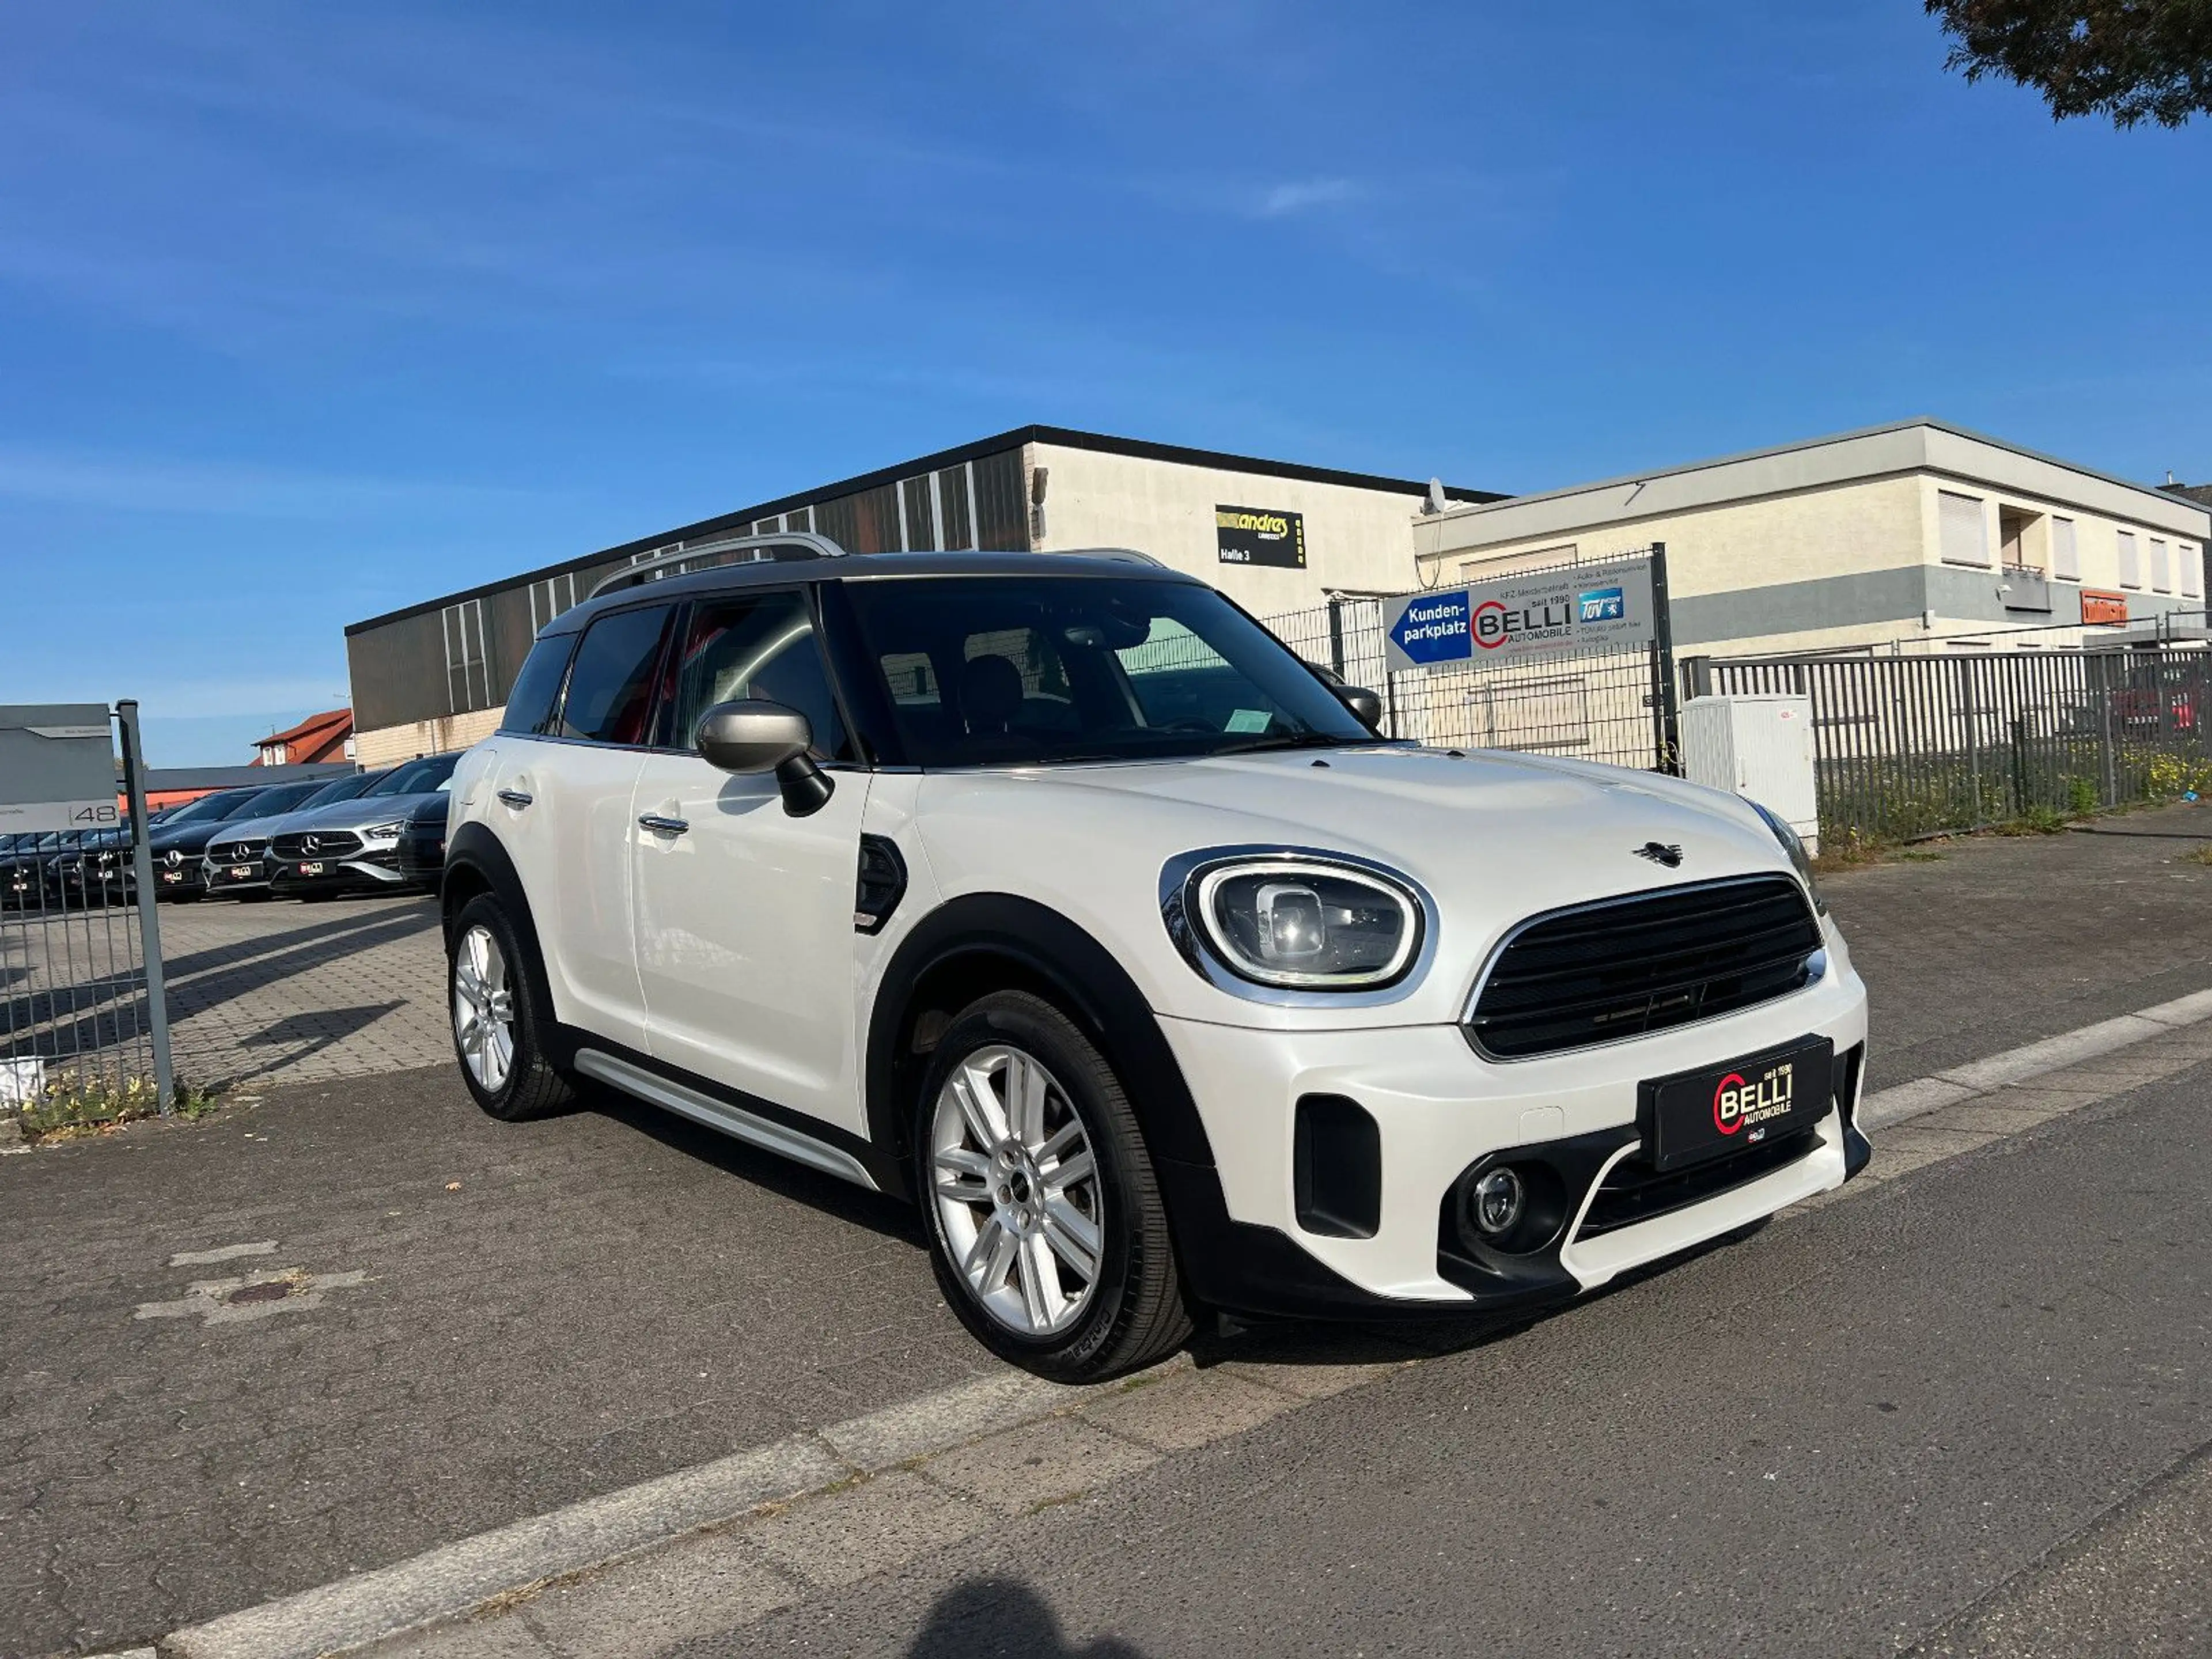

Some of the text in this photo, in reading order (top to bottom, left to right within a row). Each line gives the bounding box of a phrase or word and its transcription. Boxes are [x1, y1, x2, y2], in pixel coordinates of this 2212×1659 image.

[1220, 548, 1250, 561] Halle 3
[1532, 594, 1570, 608] seit 1990
[1409, 604, 1465, 623] Kunden-
[1479, 604, 1571, 637] BELLI
[1404, 622, 1467, 644] parkplatz
[1508, 626, 1571, 643] AUTOMOBILE
[74, 805, 116, 822] 48
[1721, 1074, 1792, 1120] BELLI
[1743, 1100, 1791, 1126] AUTOMOBILE
